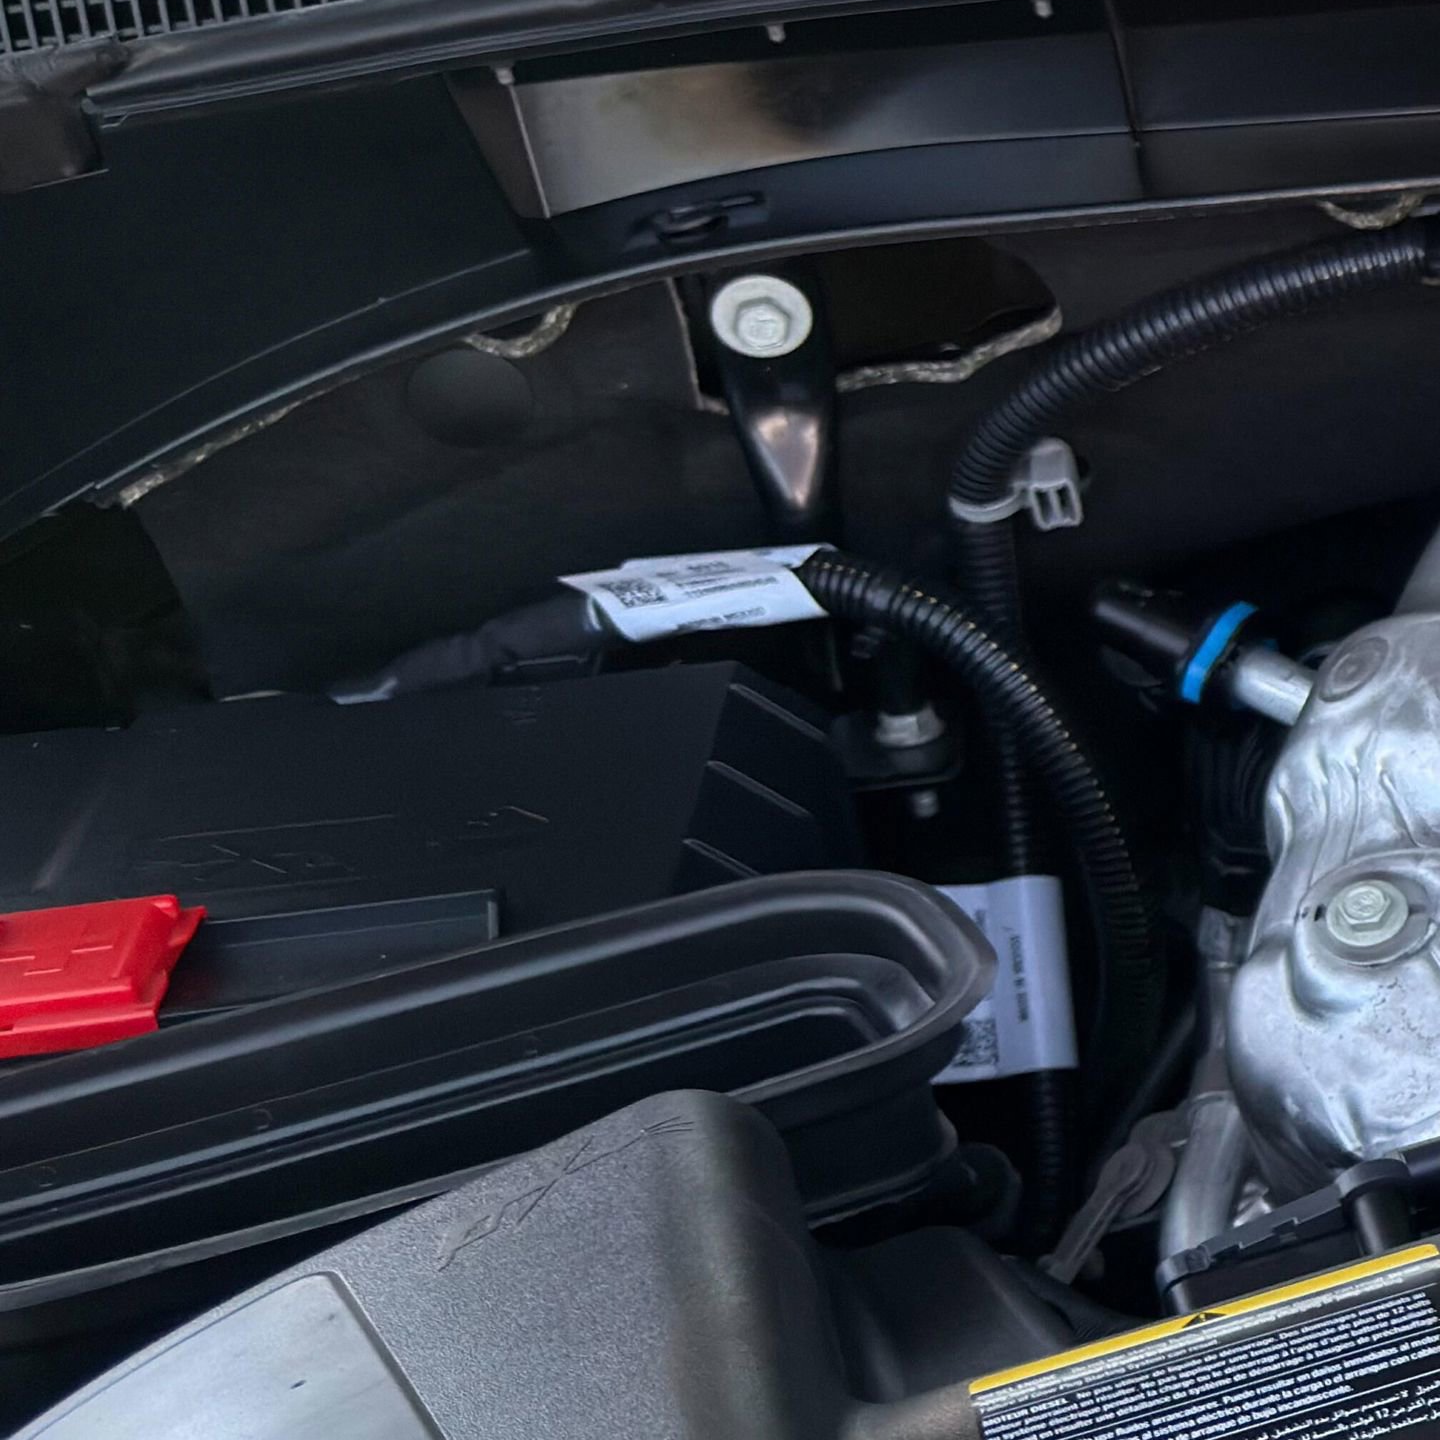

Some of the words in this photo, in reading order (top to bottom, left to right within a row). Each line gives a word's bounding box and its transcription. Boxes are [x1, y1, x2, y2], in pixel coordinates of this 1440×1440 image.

[1153, 1418, 1194, 1437] sistema
[1242, 1392, 1280, 1410] durante
[1294, 1380, 1322, 1394] carga
[1344, 1360, 1388, 1379] arranque
[1390, 1354, 1409, 1365] con
[1222, 1388, 1254, 1403] Puede
[983, 1409, 1028, 1427] MOTEUR
[1030, 1397, 1067, 1413] DIESEL
[1375, 1408, 1390, 1420] 12
[1191, 1418, 1235, 1438] arranque
[1237, 1414, 1250, 1424] de
